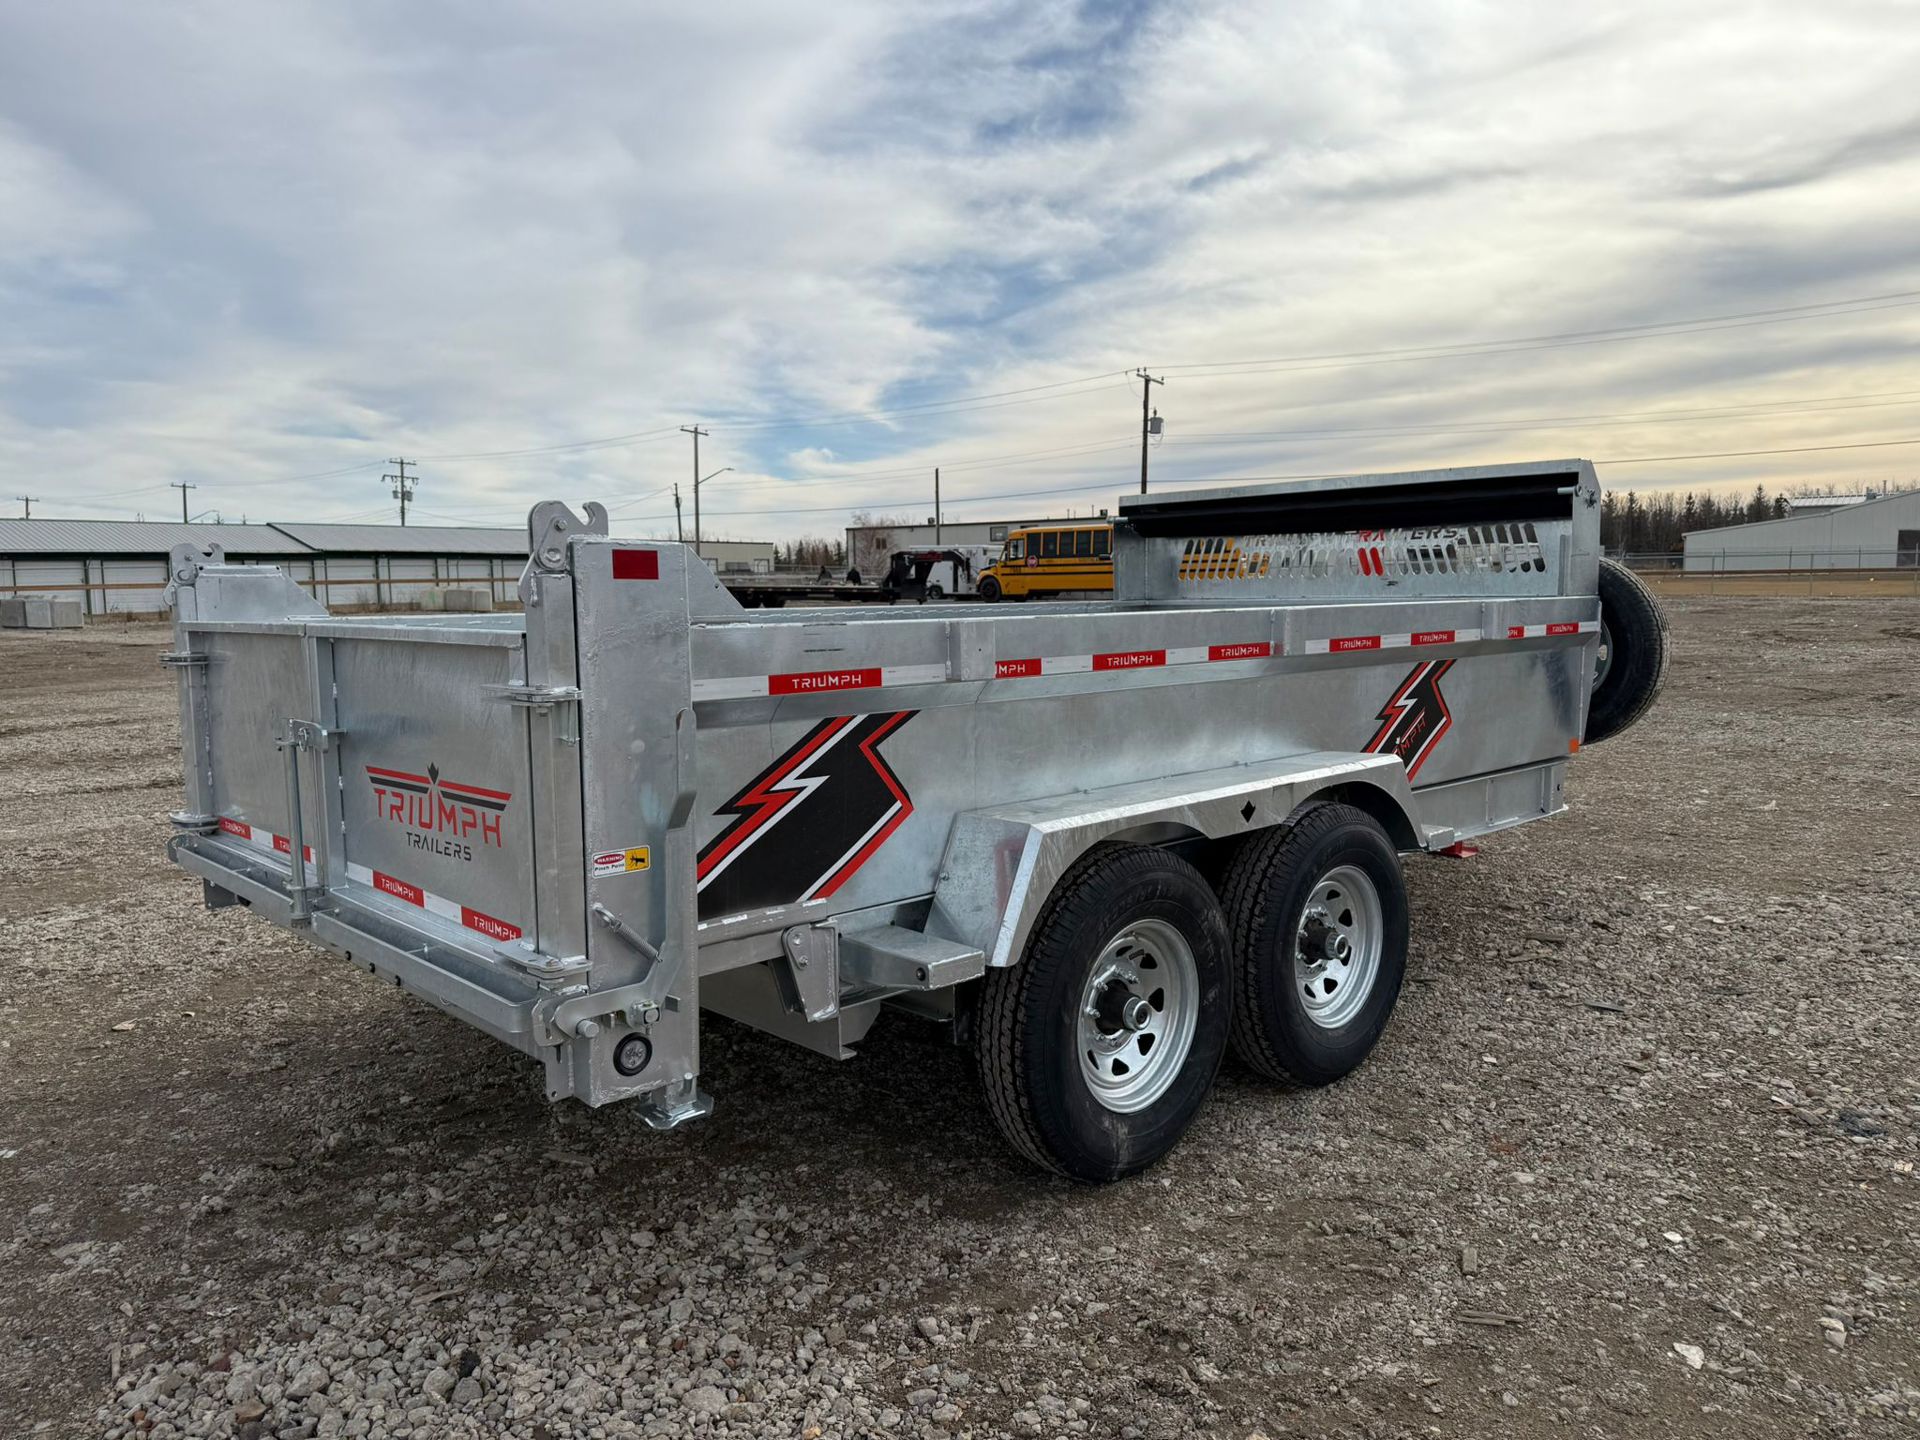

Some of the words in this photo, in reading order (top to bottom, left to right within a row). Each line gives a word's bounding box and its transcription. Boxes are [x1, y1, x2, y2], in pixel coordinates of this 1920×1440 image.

[1339, 639, 1372, 649] TRIUMPH
[1419, 634, 1447, 643] TRIUMPH
[1221, 646, 1260, 657] TRIUMPH
[1107, 654, 1153, 667] TRIUMPH
[792, 674, 863, 689] TRIUMPH
[373, 787, 502, 849] TRIUMPH
[405, 831, 472, 862] TRAILERS
[597, 855, 623, 863] WARNING
[380, 877, 415, 900] TRIUMPH
[472, 915, 517, 941] TRIUMPH
